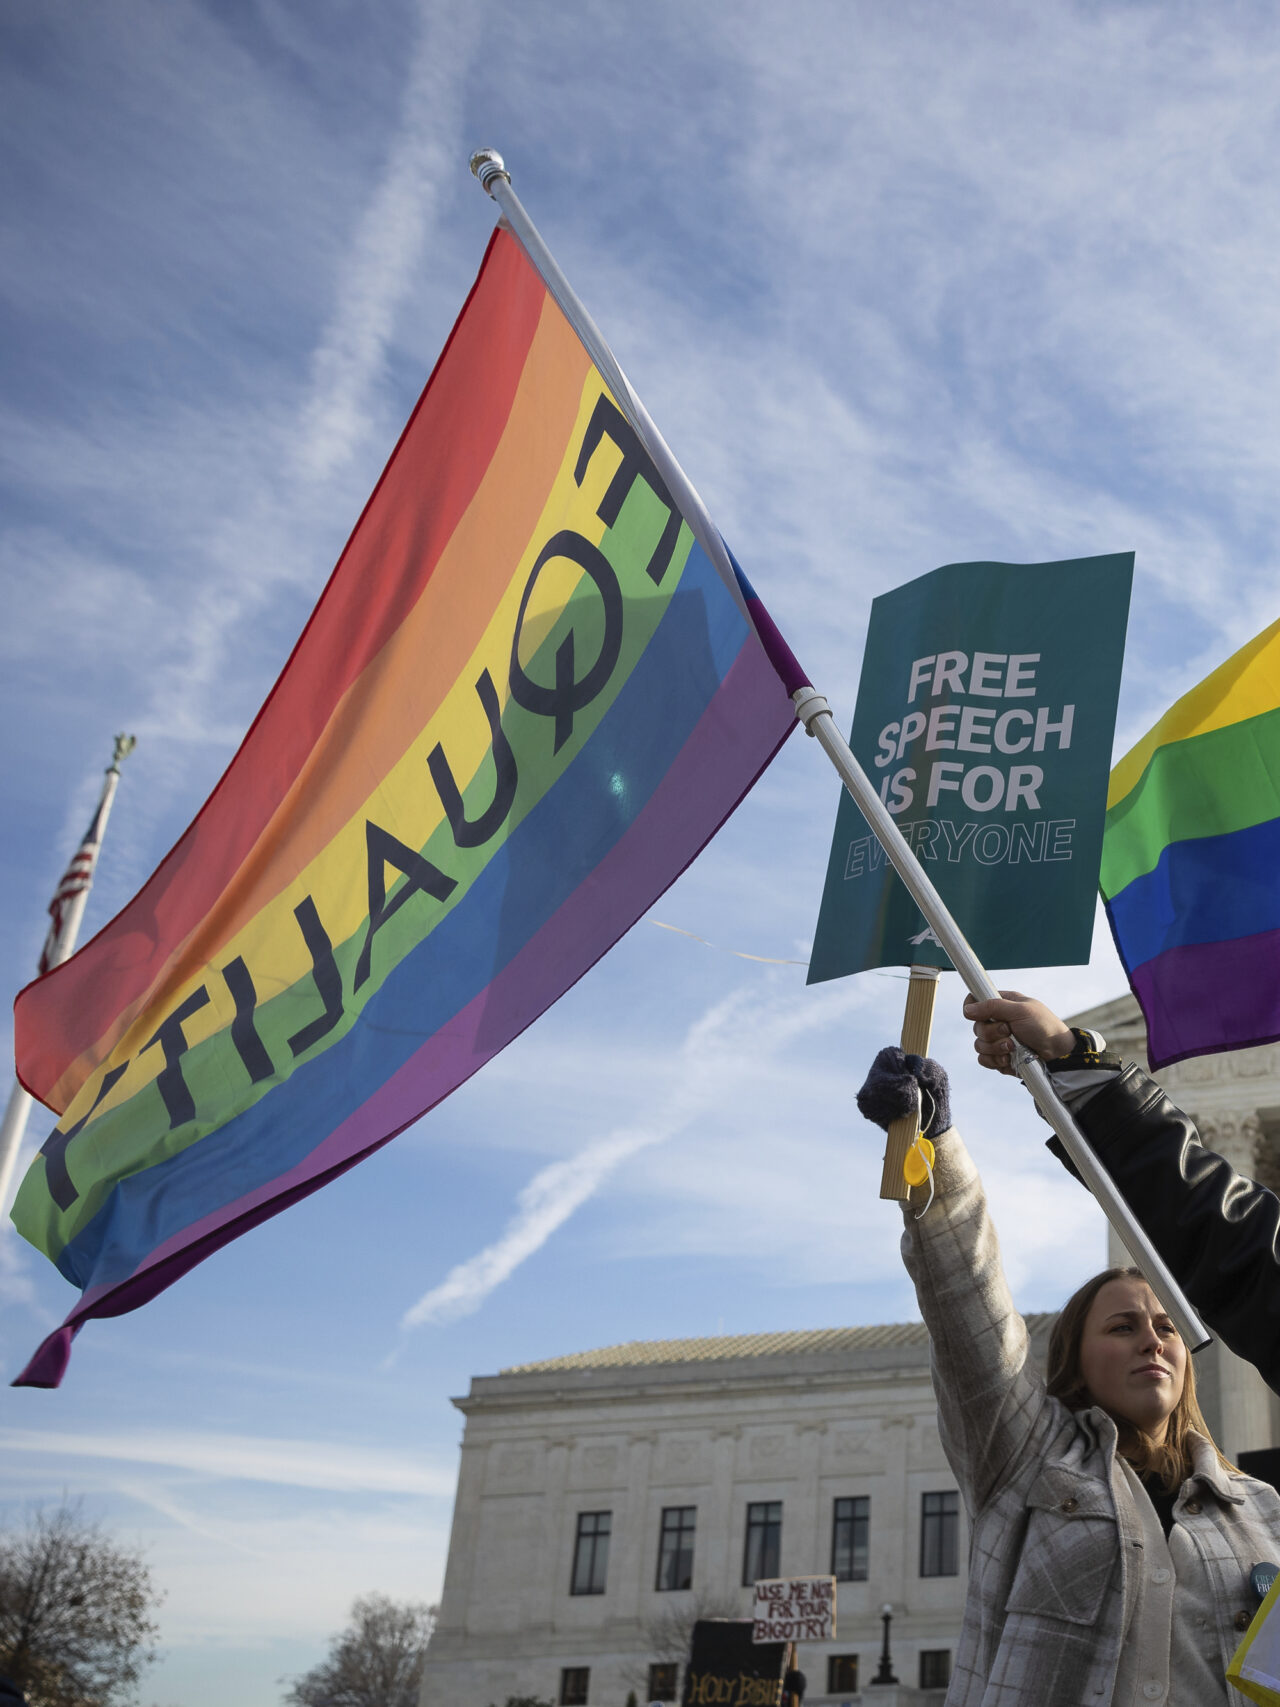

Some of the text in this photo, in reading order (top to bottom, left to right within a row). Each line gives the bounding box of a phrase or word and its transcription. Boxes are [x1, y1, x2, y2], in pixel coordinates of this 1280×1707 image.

[908, 651, 1040, 704] FREE
[874, 704, 1076, 768] SPEECH
[879, 761, 1044, 815] IS FOR
[756, 1582, 832, 1601] USE ME NOT
[768, 1600, 830, 1618] FOR YOUR
[754, 1618, 829, 1640] BIGOTRY
[687, 1672, 736, 1705] HOLY
